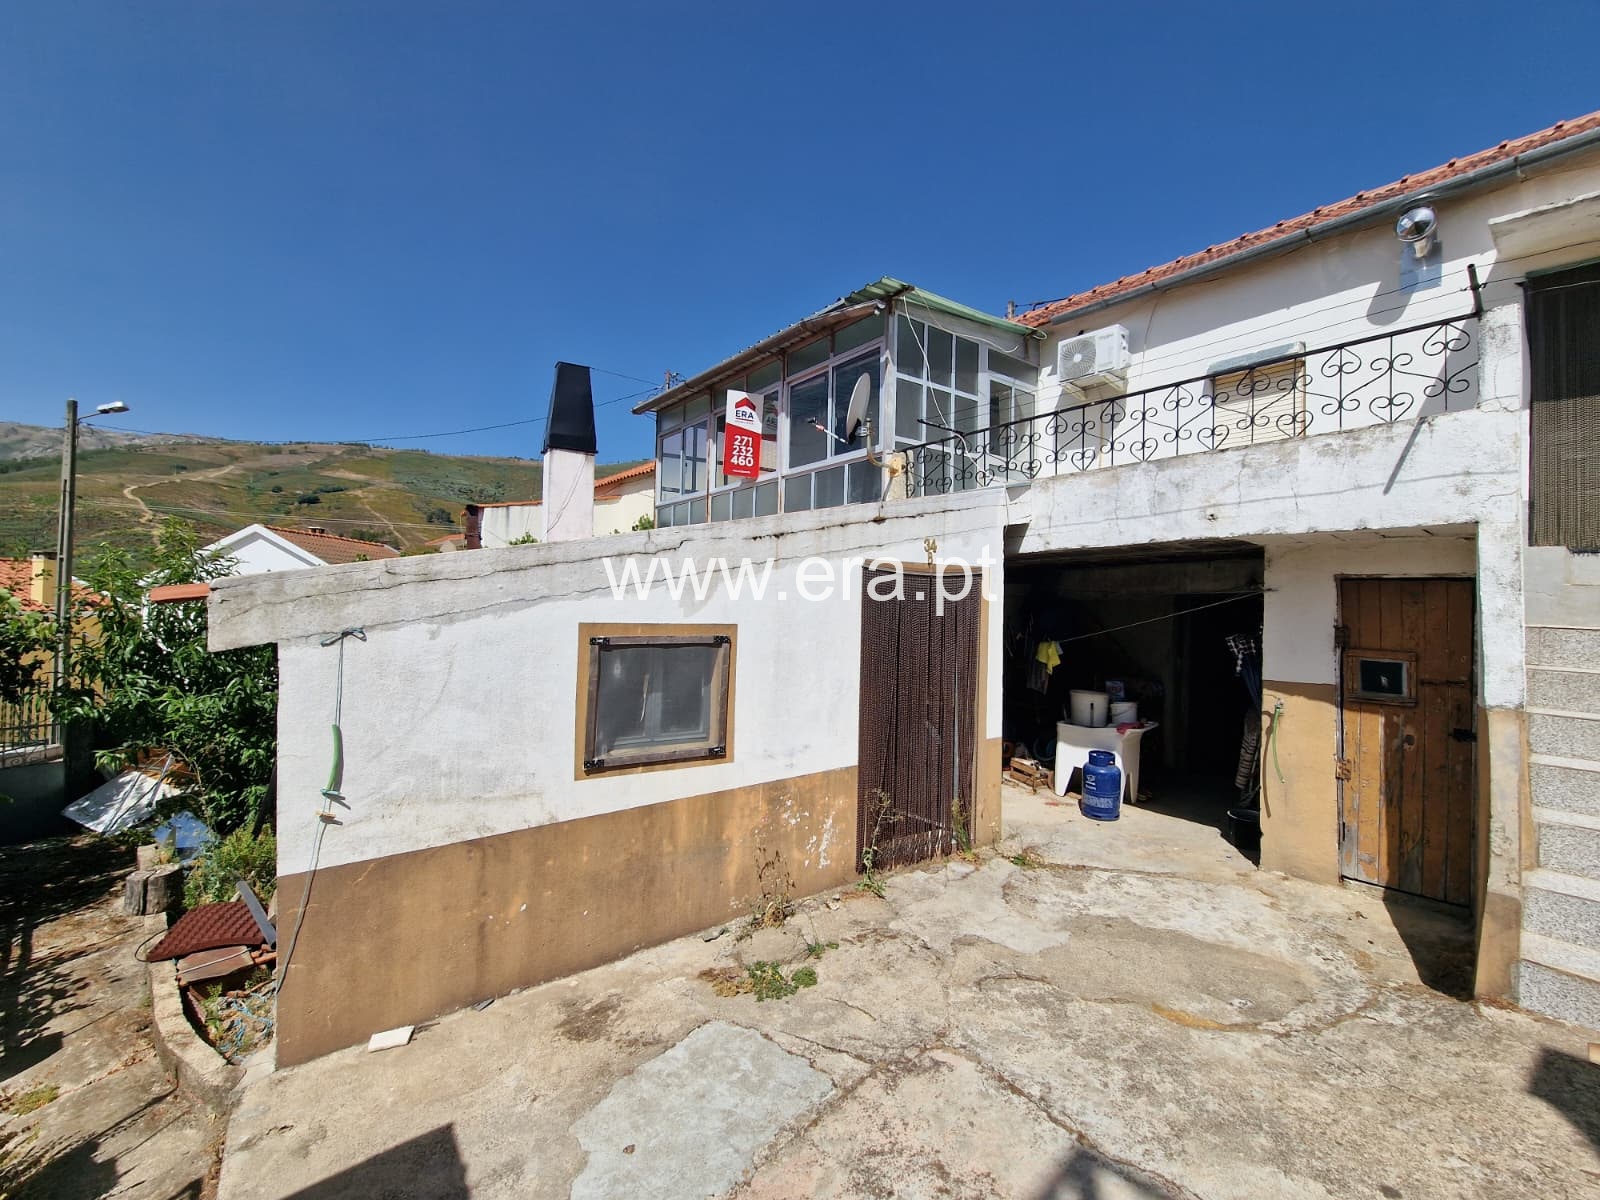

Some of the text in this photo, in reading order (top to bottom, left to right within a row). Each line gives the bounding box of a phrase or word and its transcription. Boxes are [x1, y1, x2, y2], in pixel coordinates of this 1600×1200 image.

[735, 409, 754, 419] ERA
[734, 435, 753, 447] 271
[732, 445, 753, 457] 232
[730, 455, 754, 467] 460
